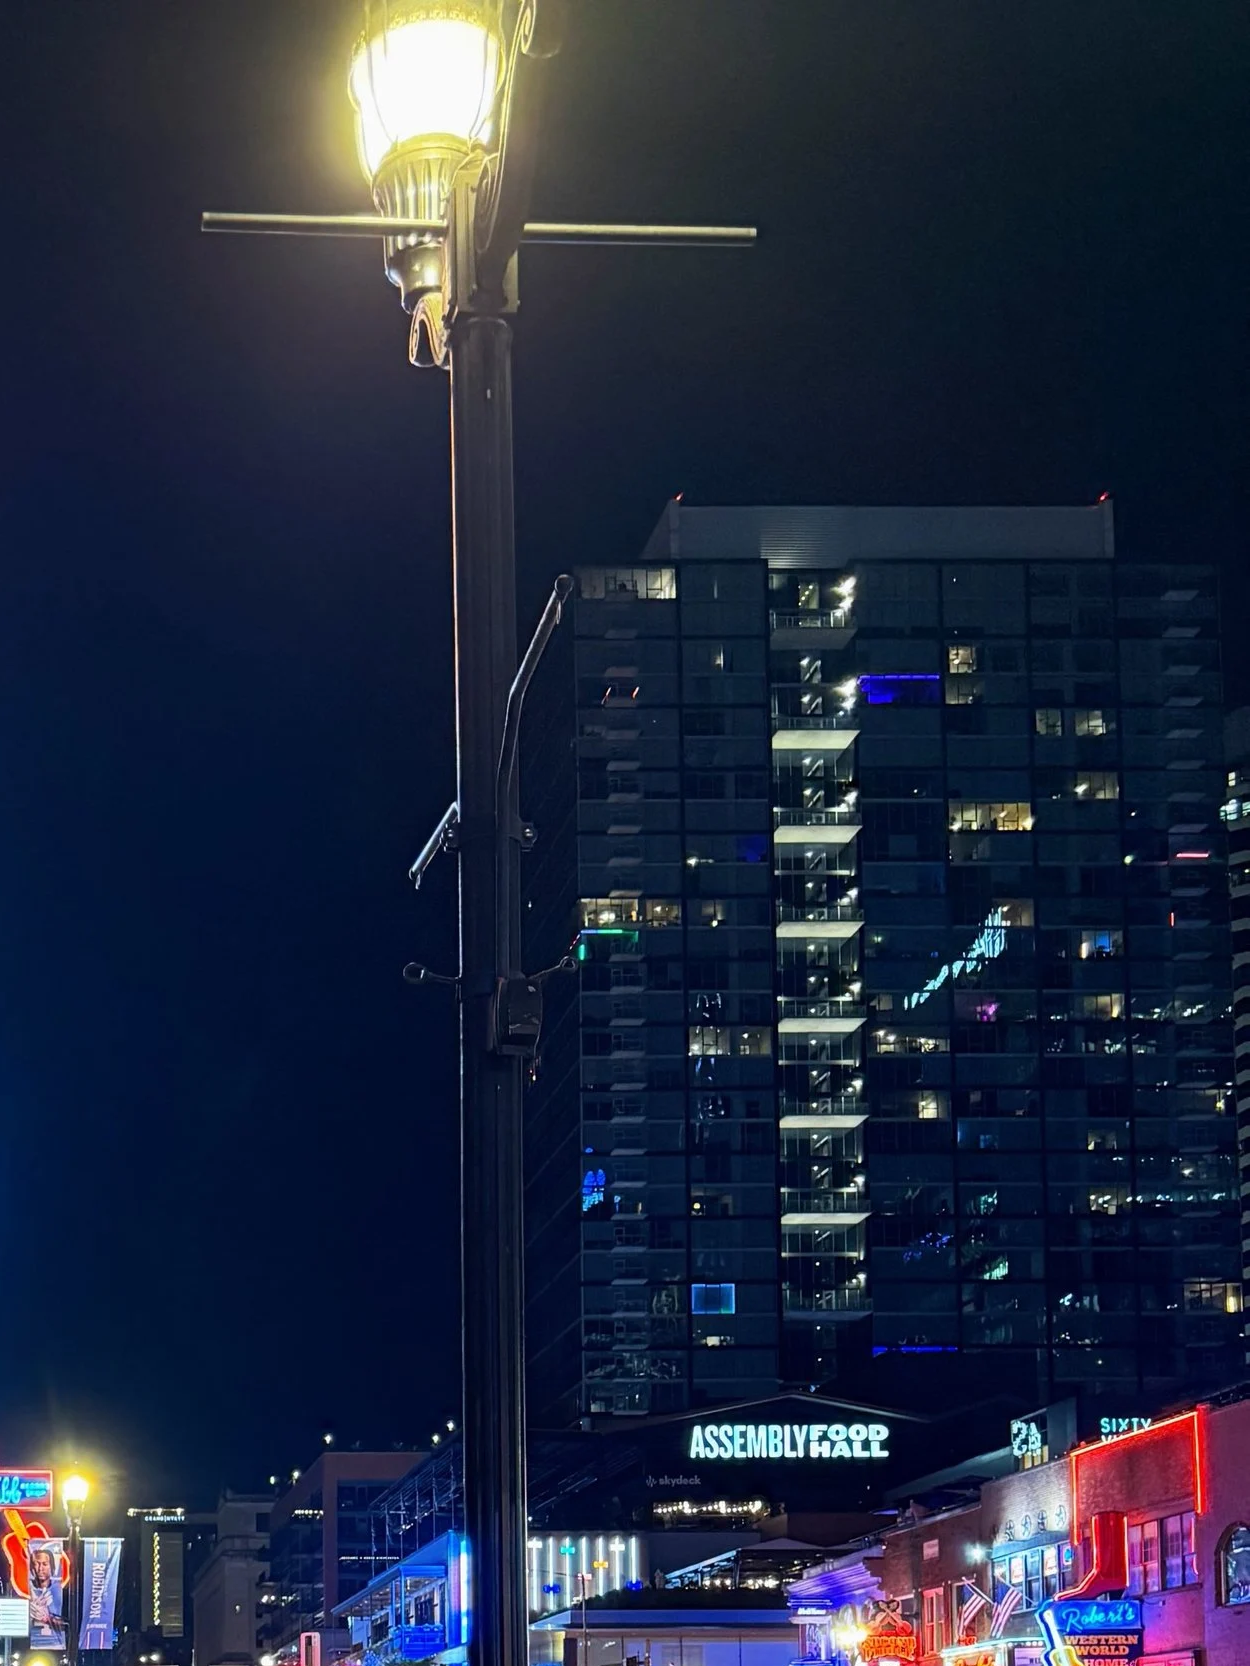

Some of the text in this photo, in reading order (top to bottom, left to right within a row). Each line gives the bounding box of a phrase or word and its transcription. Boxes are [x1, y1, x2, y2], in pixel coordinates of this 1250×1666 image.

[1100, 1417, 1152, 1433] SIXTY
[690, 1424, 890, 1458] ASSEMBLY FOOD
[809, 1441, 890, 1458] HALL
[658, 1474, 701, 1487] skydeck
[89, 1562, 106, 1619] ROBINSON
[1062, 1602, 1135, 1633] Robert's
[1064, 1635, 1139, 1645] WESTERN
[1076, 1645, 1130, 1656] WORLD
